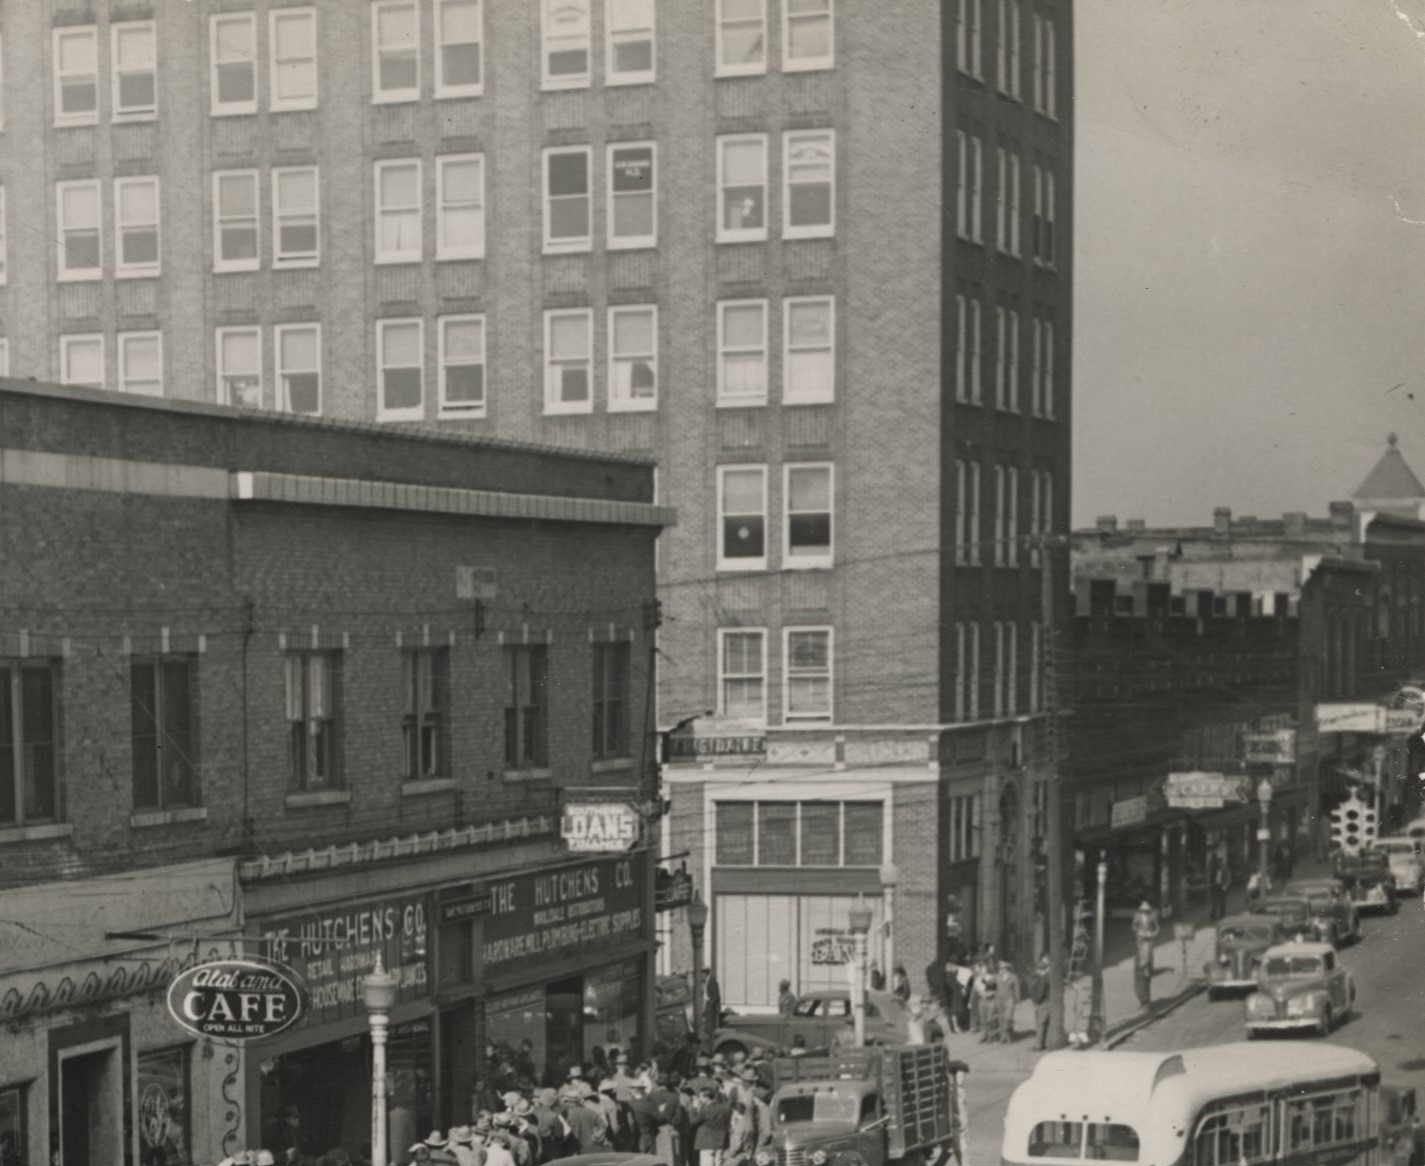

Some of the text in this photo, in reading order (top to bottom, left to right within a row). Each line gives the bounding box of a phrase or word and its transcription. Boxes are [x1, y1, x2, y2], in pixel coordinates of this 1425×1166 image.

[561, 815, 633, 838] LOANS
[490, 883, 516, 915] THE
[534, 867, 599, 905] HUTCHENS
[615, 861, 633, 888] CO.
[611, 908, 641, 933] SUPPLIES
[264, 929, 289, 964] THE
[301, 907, 395, 957] HUTCHENS
[307, 958, 334, 979] RETAIL
[183, 991, 286, 1022] CAFE
[203, 1023, 264, 1033] OPEN ALL NITE
